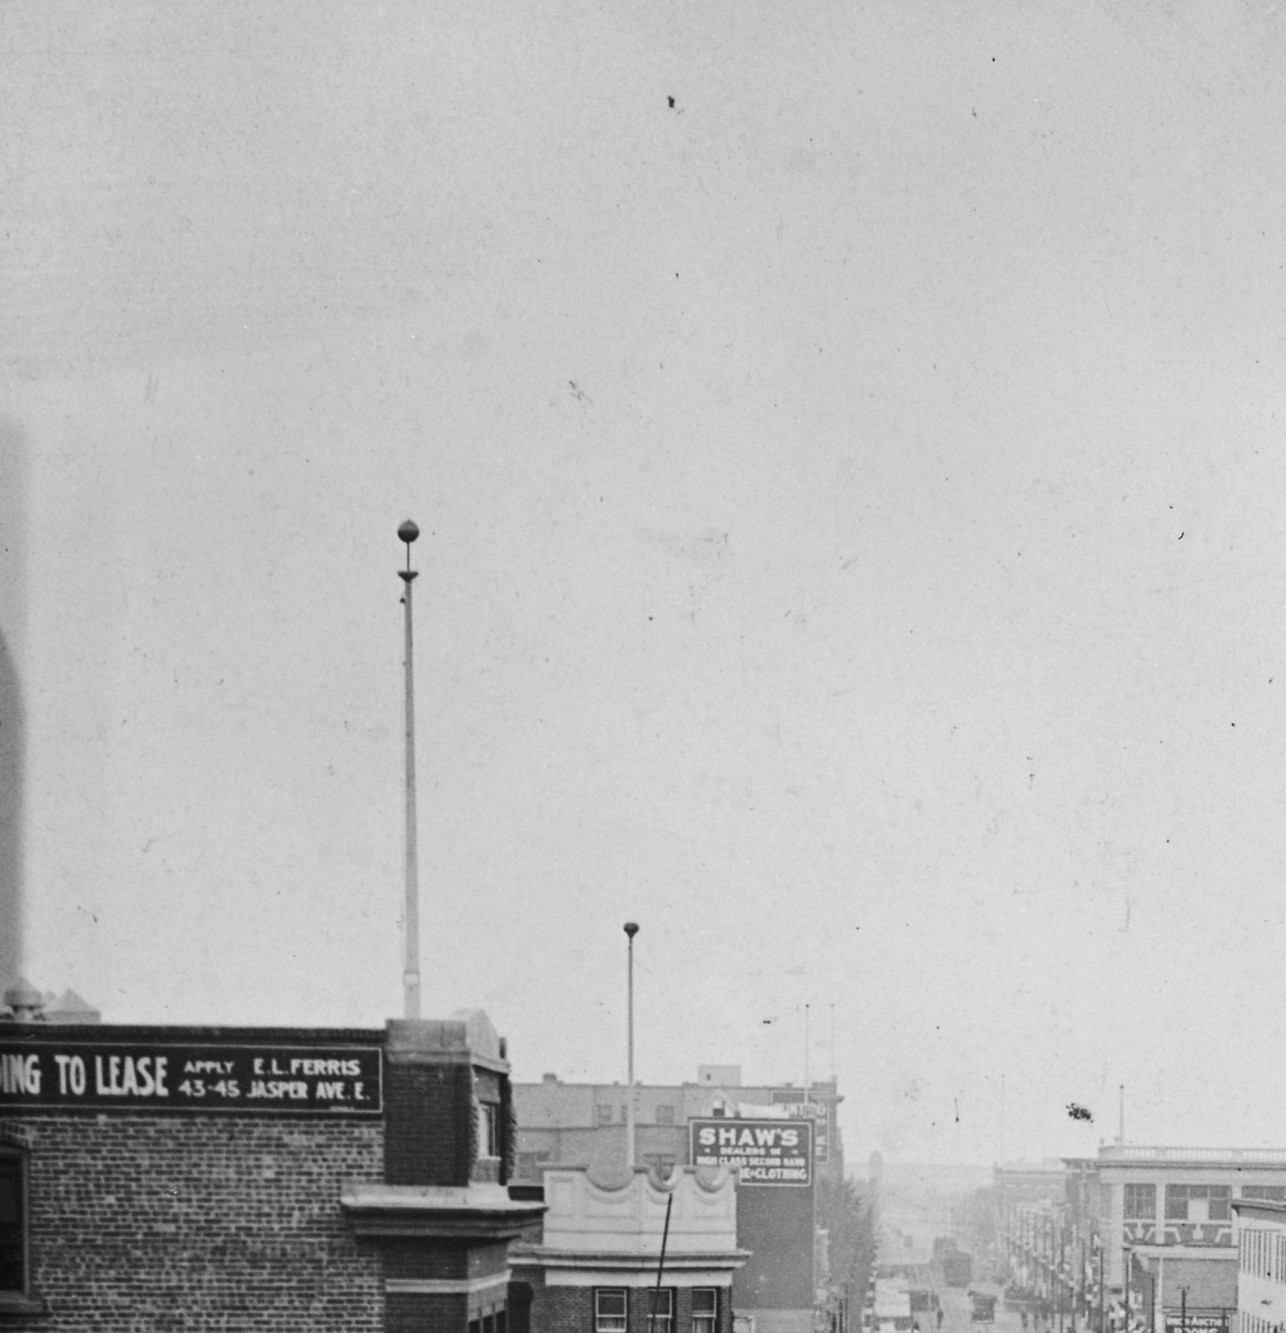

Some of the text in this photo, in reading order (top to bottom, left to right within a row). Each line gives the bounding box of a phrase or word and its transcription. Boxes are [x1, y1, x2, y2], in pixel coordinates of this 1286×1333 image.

[55, 1055, 85, 1095] TO
[96, 1055, 169, 1096] LEASE
[184, 1060, 234, 1074] APPLY
[178, 1080, 240, 1098] 43-45
[247, 1081, 308, 1099] JASPER
[699, 1128, 799, 1146] SHAW'S
